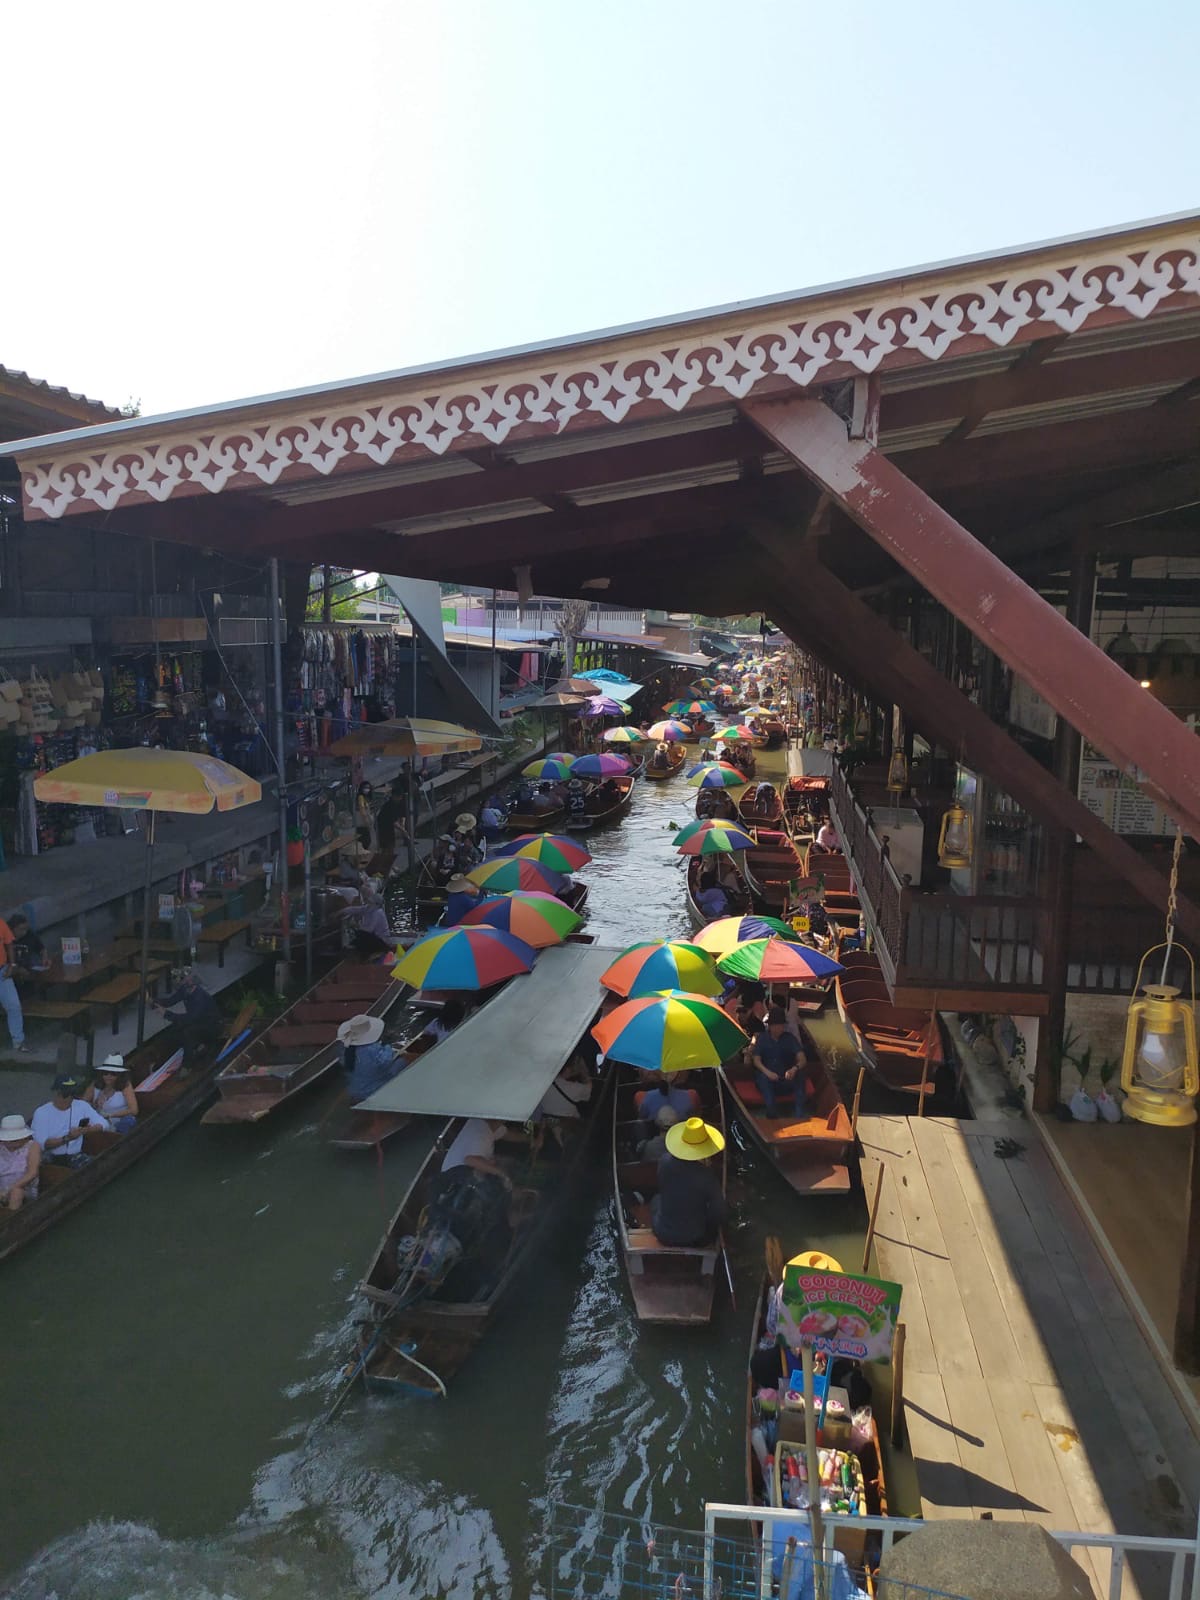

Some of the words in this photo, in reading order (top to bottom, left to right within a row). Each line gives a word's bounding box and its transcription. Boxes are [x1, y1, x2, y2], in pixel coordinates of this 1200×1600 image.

[799, 1274, 887, 1305] COCONUT
[804, 1290, 826, 1304] ICE
[829, 1291, 876, 1315] CREAM
